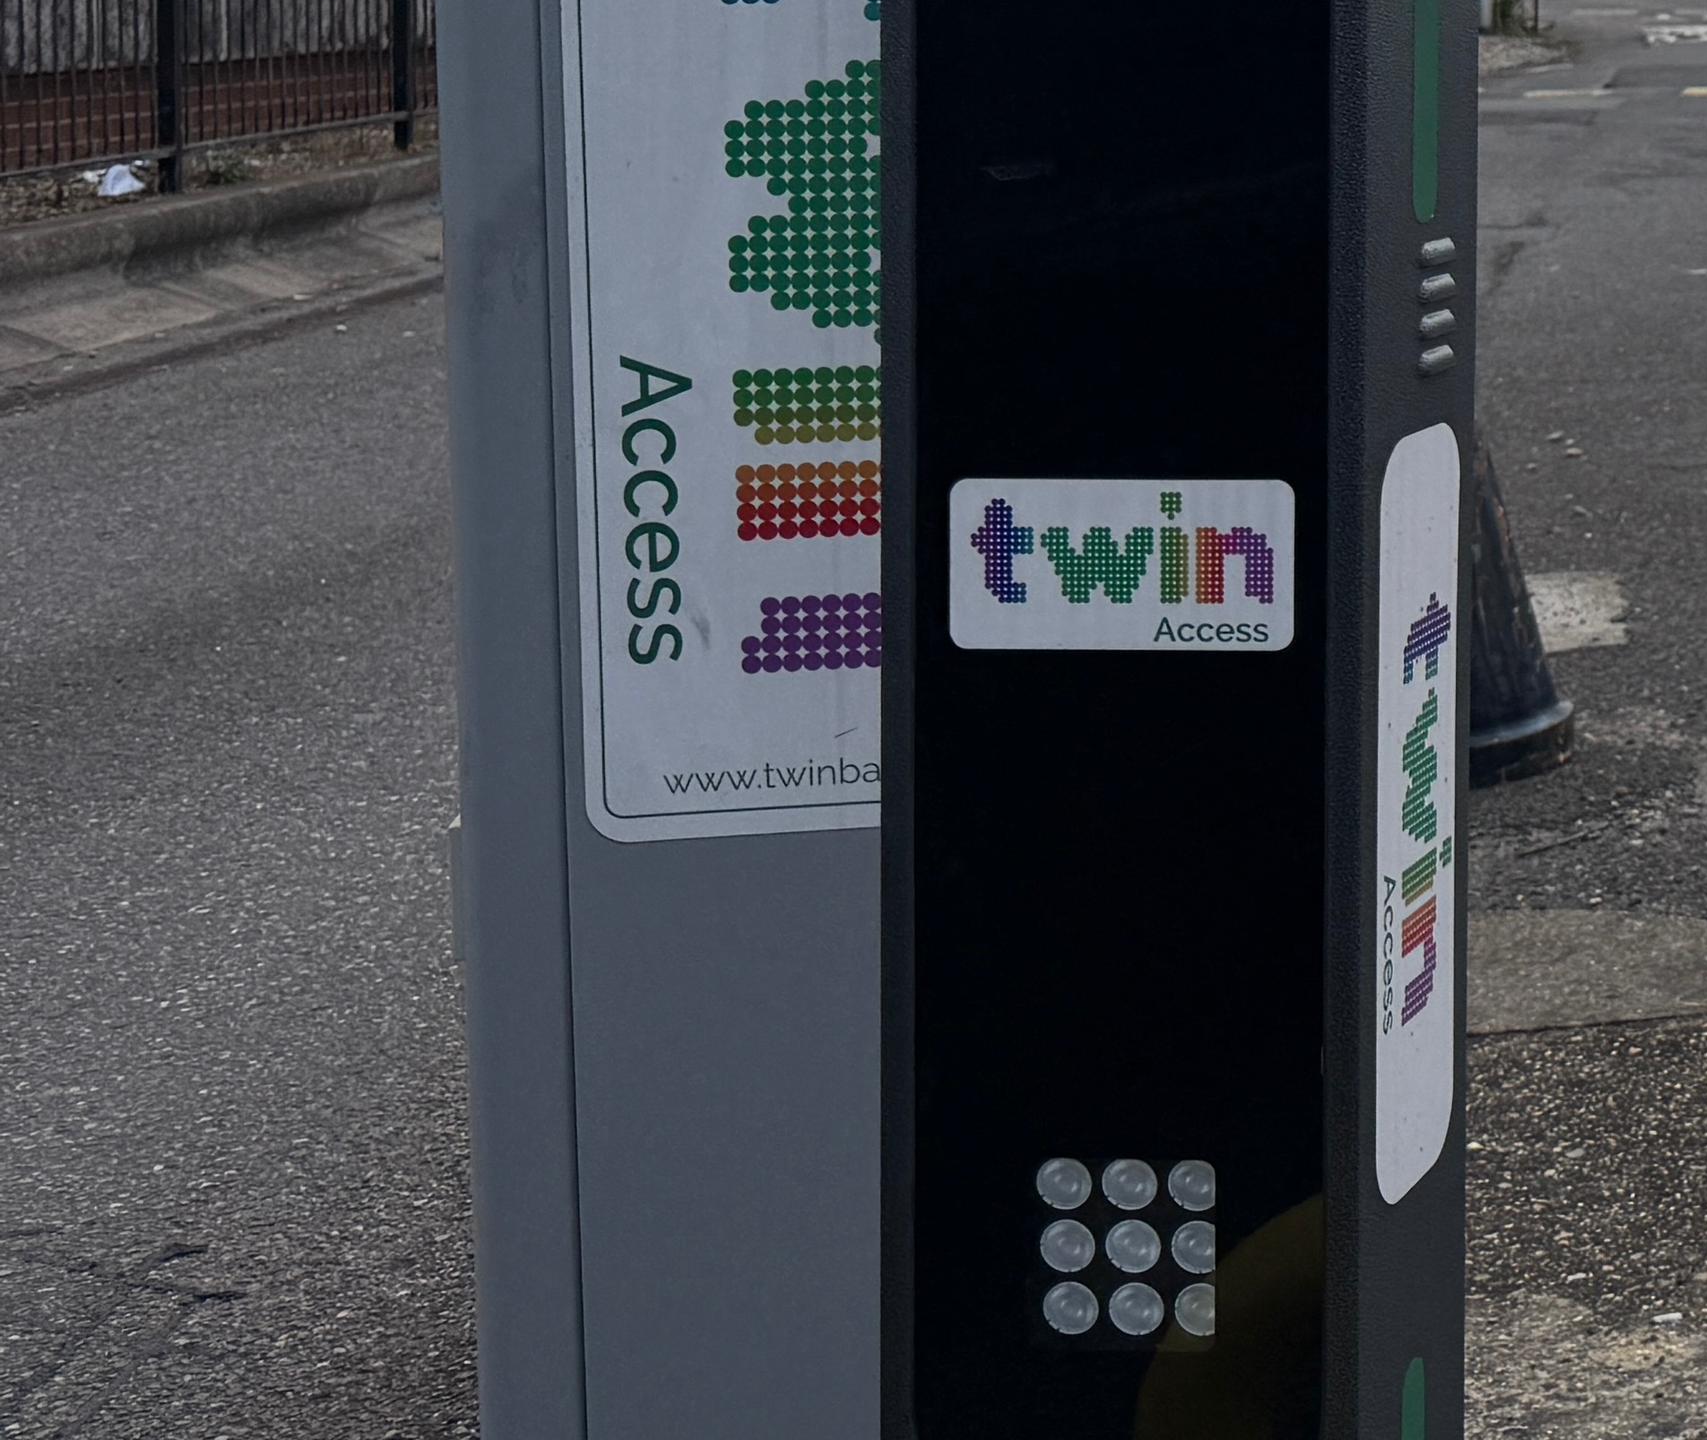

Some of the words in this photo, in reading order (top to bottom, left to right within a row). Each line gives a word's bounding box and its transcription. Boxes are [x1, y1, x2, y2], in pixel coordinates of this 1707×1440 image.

[618, 353, 693, 666] Access
[970, 491, 1274, 604] twin
[1153, 616, 1270, 644] Access
[663, 757, 881, 795] www.twinba
[1400, 591, 1452, 1027] twin
[1380, 874, 1395, 1036] Access
